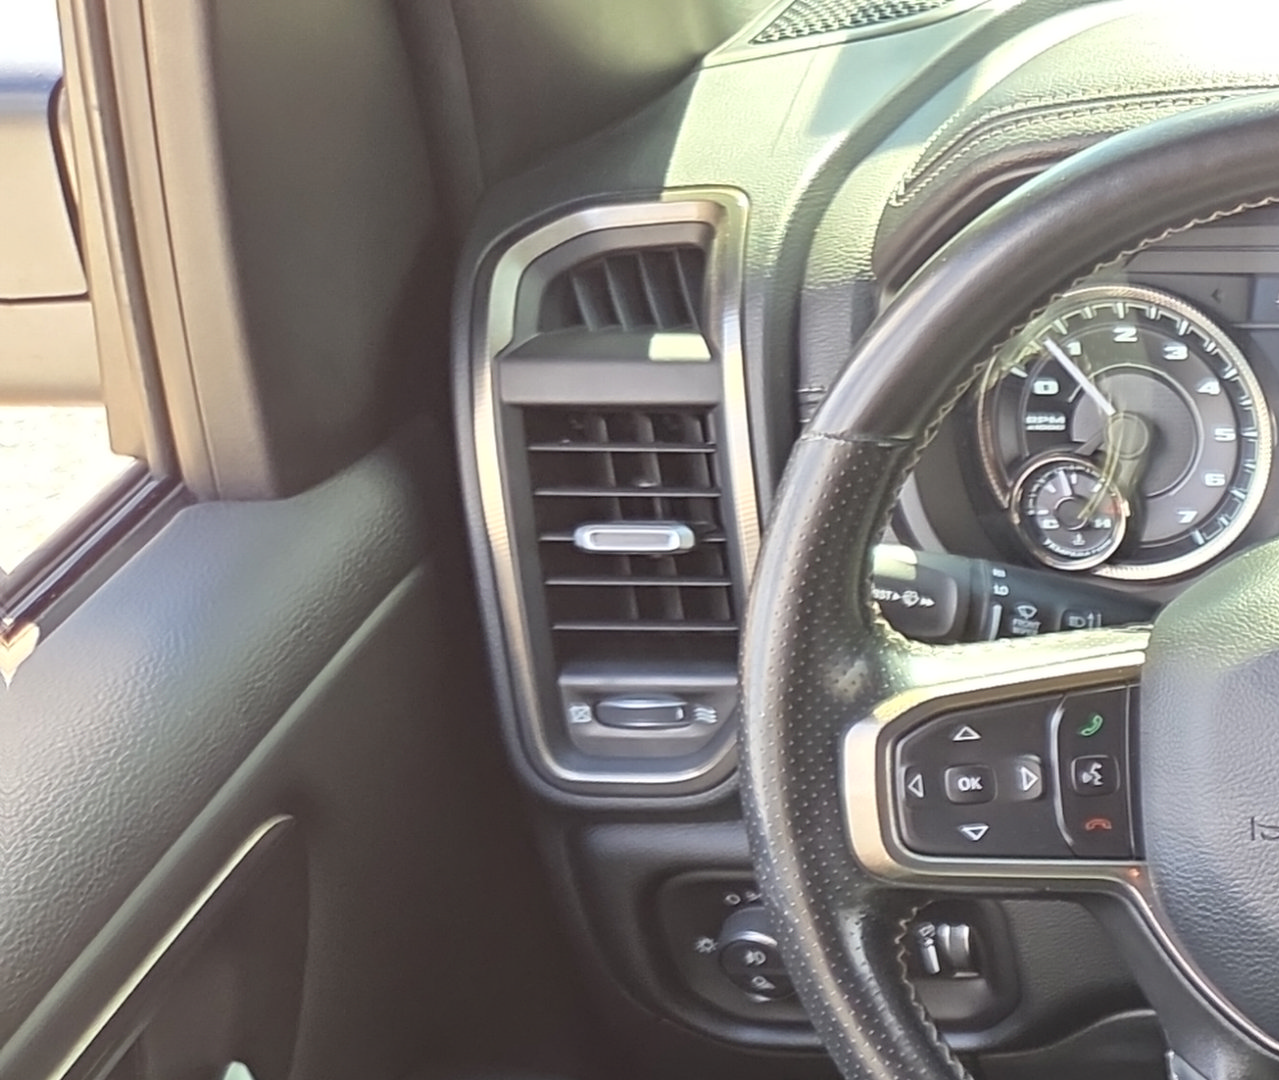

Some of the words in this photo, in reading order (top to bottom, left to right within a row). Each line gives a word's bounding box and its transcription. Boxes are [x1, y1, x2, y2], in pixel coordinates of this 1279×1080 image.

[1113, 326, 1138, 342] 2
[1067, 341, 1082, 355] 1
[1163, 343, 1188, 360] 3
[1197, 380, 1220, 395] 4
[1214, 427, 1236, 441] 5
[1205, 473, 1225, 487] 6
[1177, 510, 1198, 524] 7
[958, 777, 983, 792] OK
